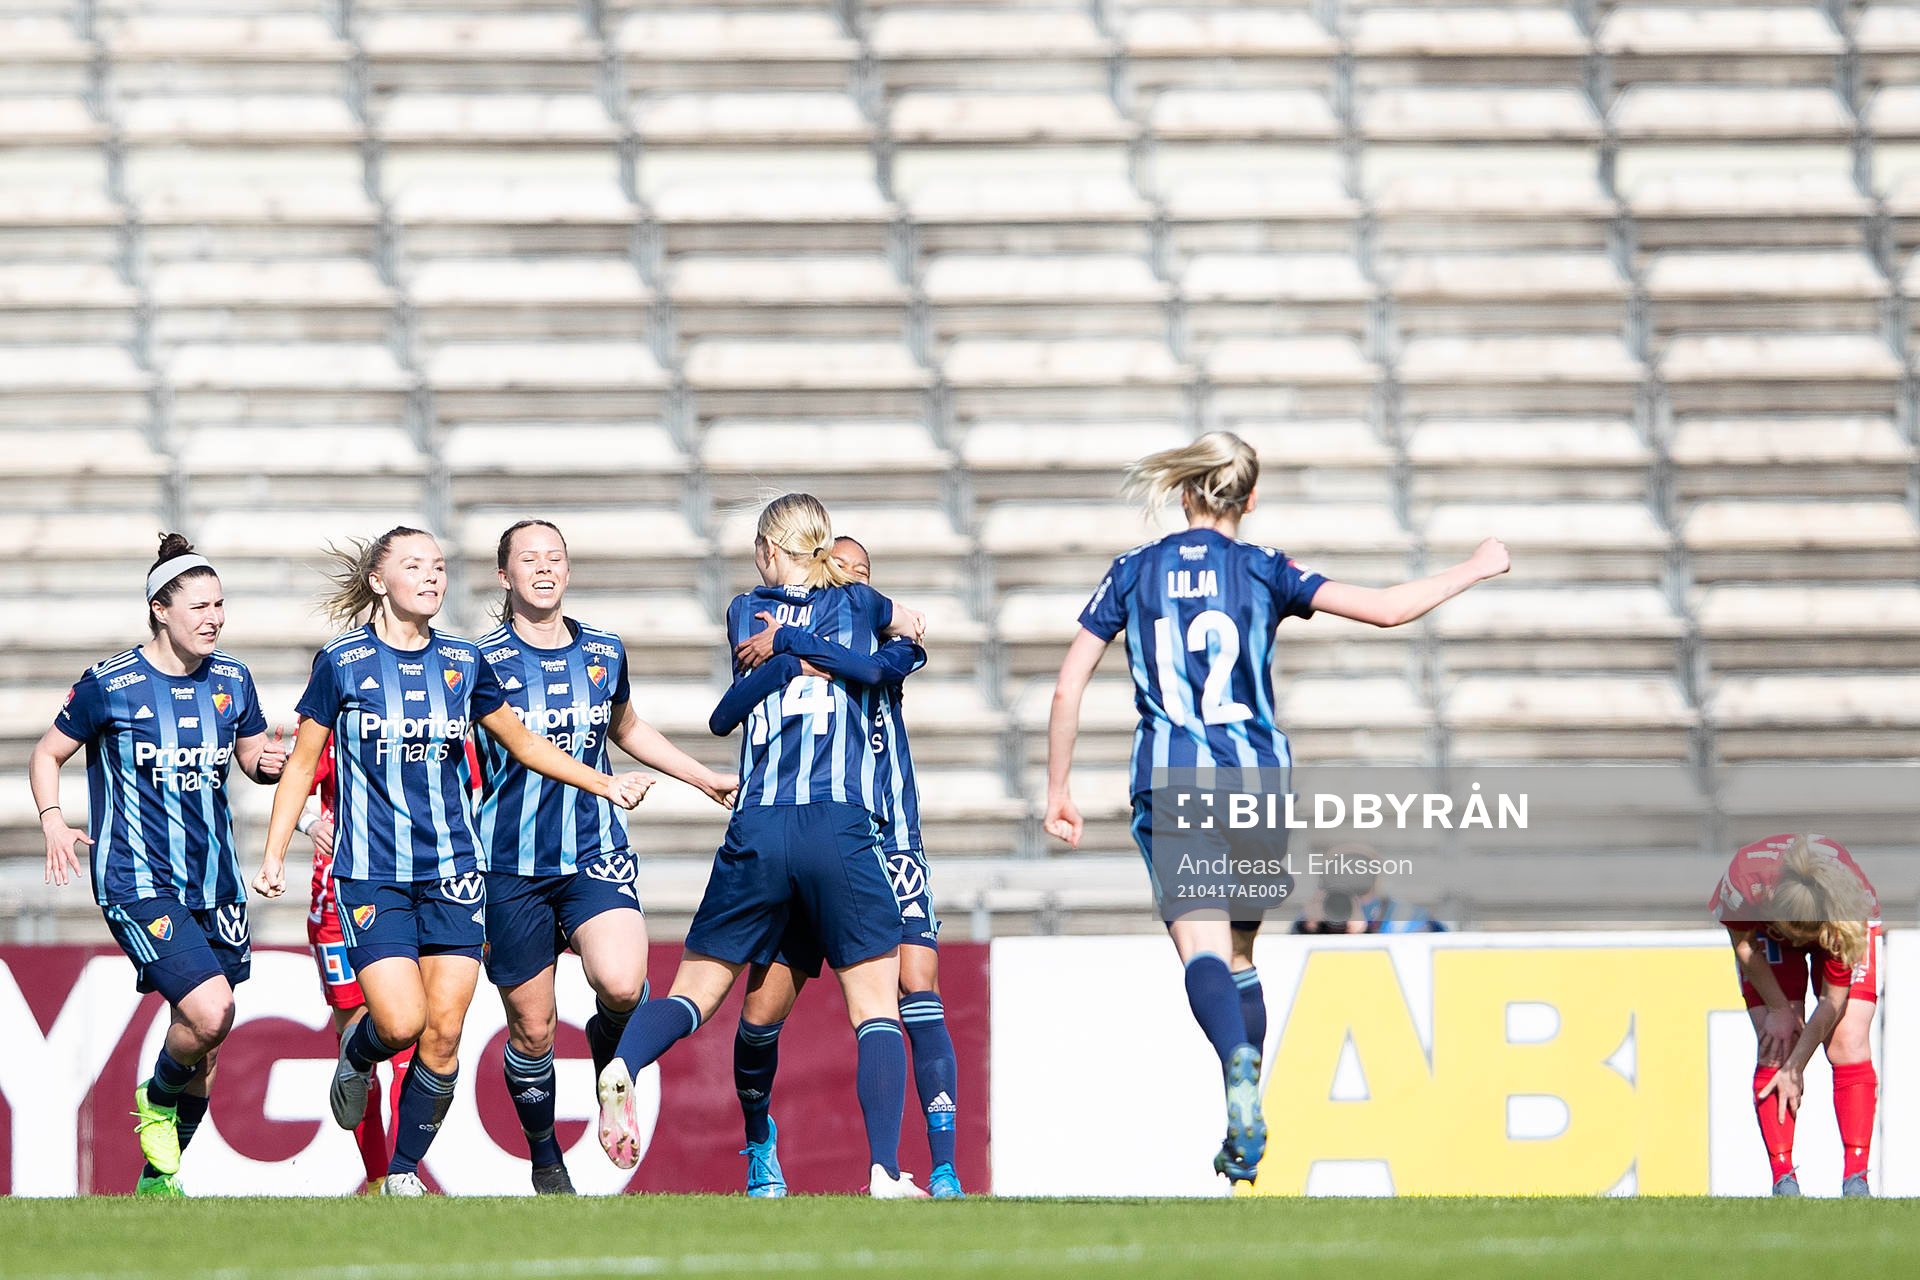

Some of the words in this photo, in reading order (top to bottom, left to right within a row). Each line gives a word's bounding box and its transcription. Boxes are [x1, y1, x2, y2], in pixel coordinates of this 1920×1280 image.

[1168, 570, 1218, 598] LILJA
[776, 604, 814, 627] OLAI
[488, 649, 520, 664] ELLNESS
[1154, 610, 1254, 727] 12
[547, 683, 570, 695] ABT
[360, 711, 467, 741] Prioritet
[135, 742, 233, 767] Prioritet
[376, 738, 450, 765] Finans
[153, 768, 221, 792] Finans
[1234, 947, 1748, 1197] ABT
[928, 1104, 956, 1112] adidas
